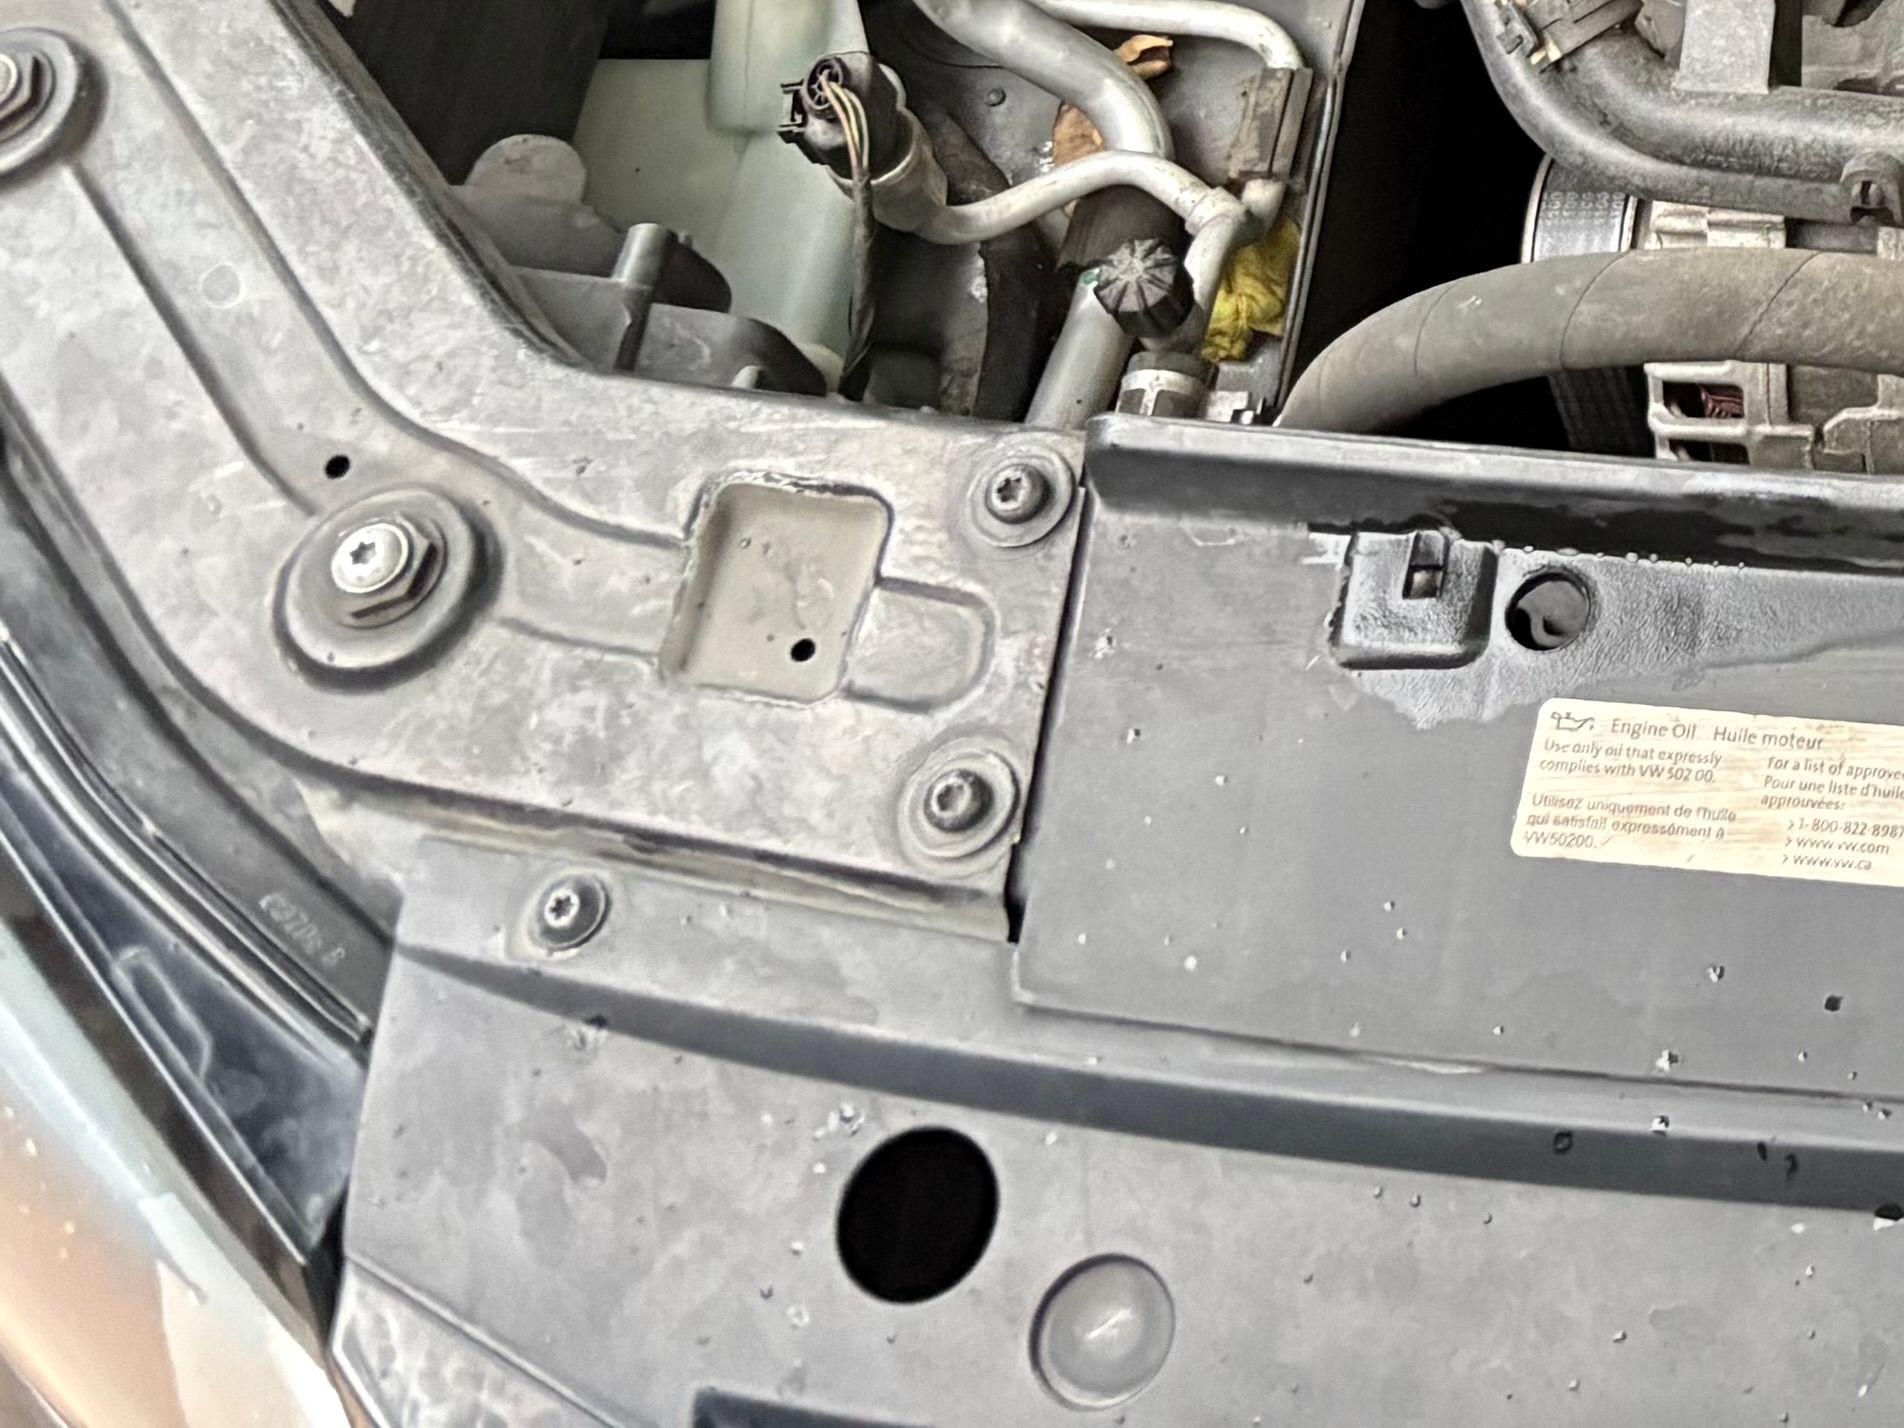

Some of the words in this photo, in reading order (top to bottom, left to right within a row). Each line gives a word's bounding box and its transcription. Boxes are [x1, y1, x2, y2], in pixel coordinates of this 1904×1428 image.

[1610, 718, 1669, 742] Engine
[1671, 723, 1697, 740] Oil
[1712, 726, 1758, 744] Huile
[1761, 730, 1826, 750] moteur
[1544, 737, 1570, 753] Use
[1571, 739, 1603, 760] only
[1604, 741, 1622, 756] oil
[1626, 743, 1655, 758] that
[1657, 745, 1723, 768] expressly
[1539, 755, 1601, 778] complies
[1603, 760, 1636, 776] with
[1638, 763, 1665, 779] VW
[1666, 765, 1692, 781] 502
[1767, 756, 1789, 771] For
[1792, 761, 1801, 772] a
[1803, 759, 1826, 774] list
[1828, 761, 1845, 776] of
[1763, 774, 1797, 791] Pour
[1799, 780, 1824, 793] une
[1828, 779, 1858, 796] liste
[1586, 797, 1671, 821] uniquement
[1673, 803, 1692, 818] de
[1526, 812, 1550, 832] qui
[1796, 837, 1890, 855] www.vw.com
